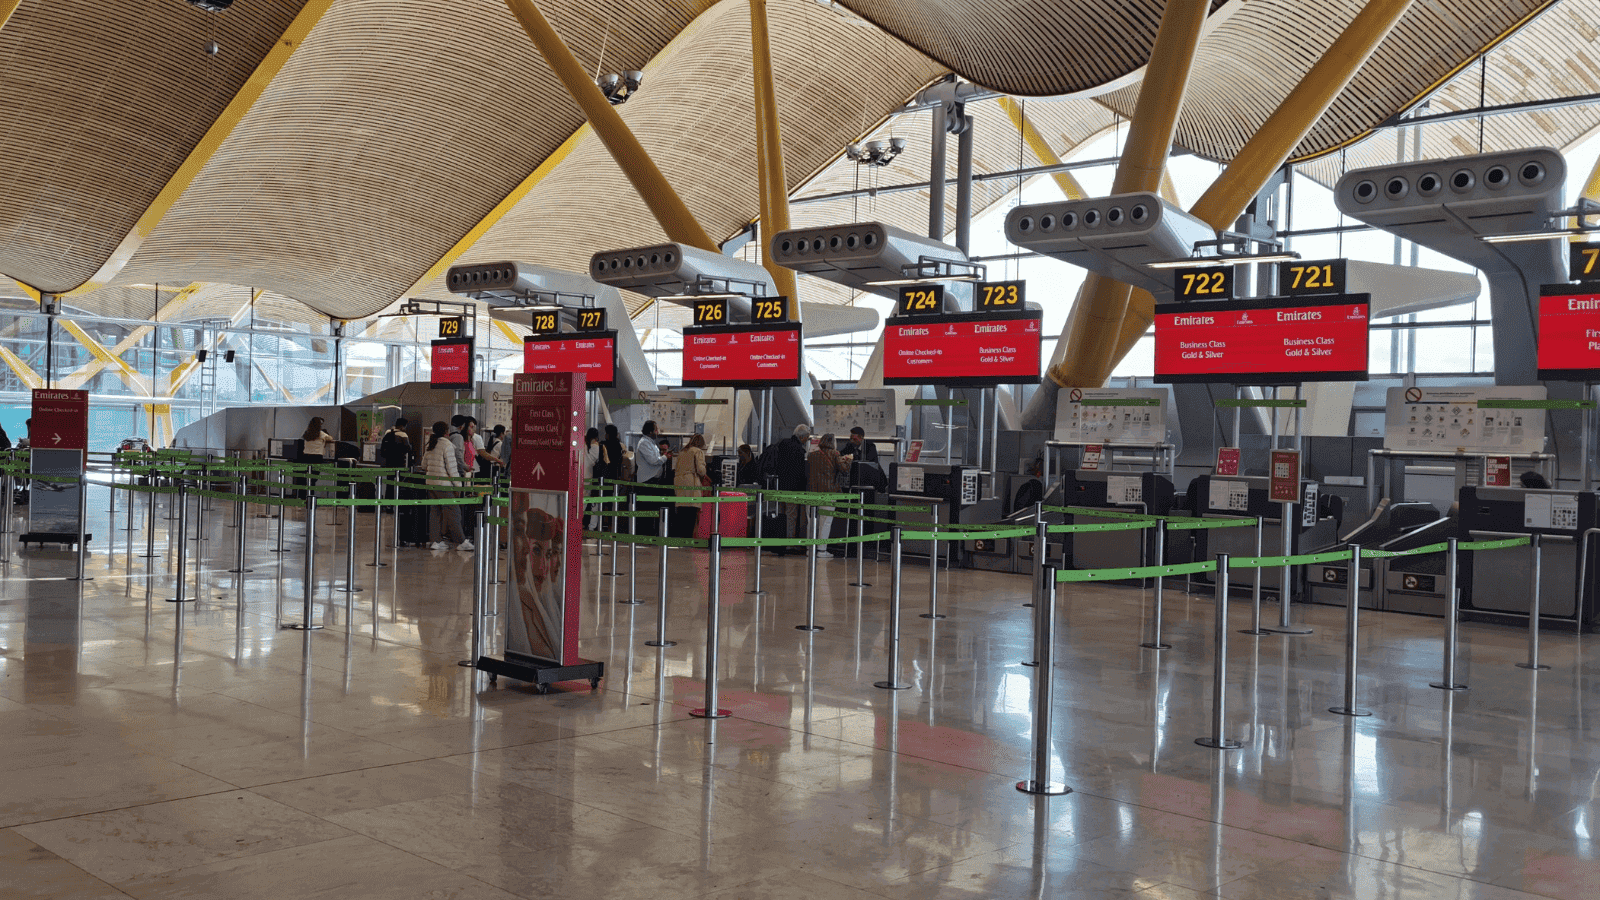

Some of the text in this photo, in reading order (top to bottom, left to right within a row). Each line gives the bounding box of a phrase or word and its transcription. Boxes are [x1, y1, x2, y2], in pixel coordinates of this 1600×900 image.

[1290, 264, 1335, 289] 721
[1182, 271, 1226, 296] 722
[905, 290, 937, 311] 724
[983, 285, 1018, 305] 723
[697, 304, 722, 321] 726
[756, 301, 782, 319] 725
[580, 312, 601, 328] 727
[1173, 315, 1215, 326] Emirates
[1276, 310, 1322, 322] Emirates
[442, 320, 458, 334] 729
[535, 314, 555, 331] 728
[898, 326, 930, 337] Emirates
[974, 323, 1008, 334] Emirates
[750, 334, 775, 342] Emirates
[1283, 336, 1335, 346] Business Class
[979, 346, 1017, 354] Business Class
[1180, 340, 1226, 349] Business Class
[1181, 351, 1198, 359] Gold
[1205, 350, 1225, 359] Silver
[1285, 348, 1333, 357] Gold & Silver
[980, 354, 1015, 363] Gold & Silver
[515, 378, 554, 393] Emirates
[35, 391, 69, 399] Emirates
[541, 409, 554, 418] Class
[524, 423, 546, 432] Business
